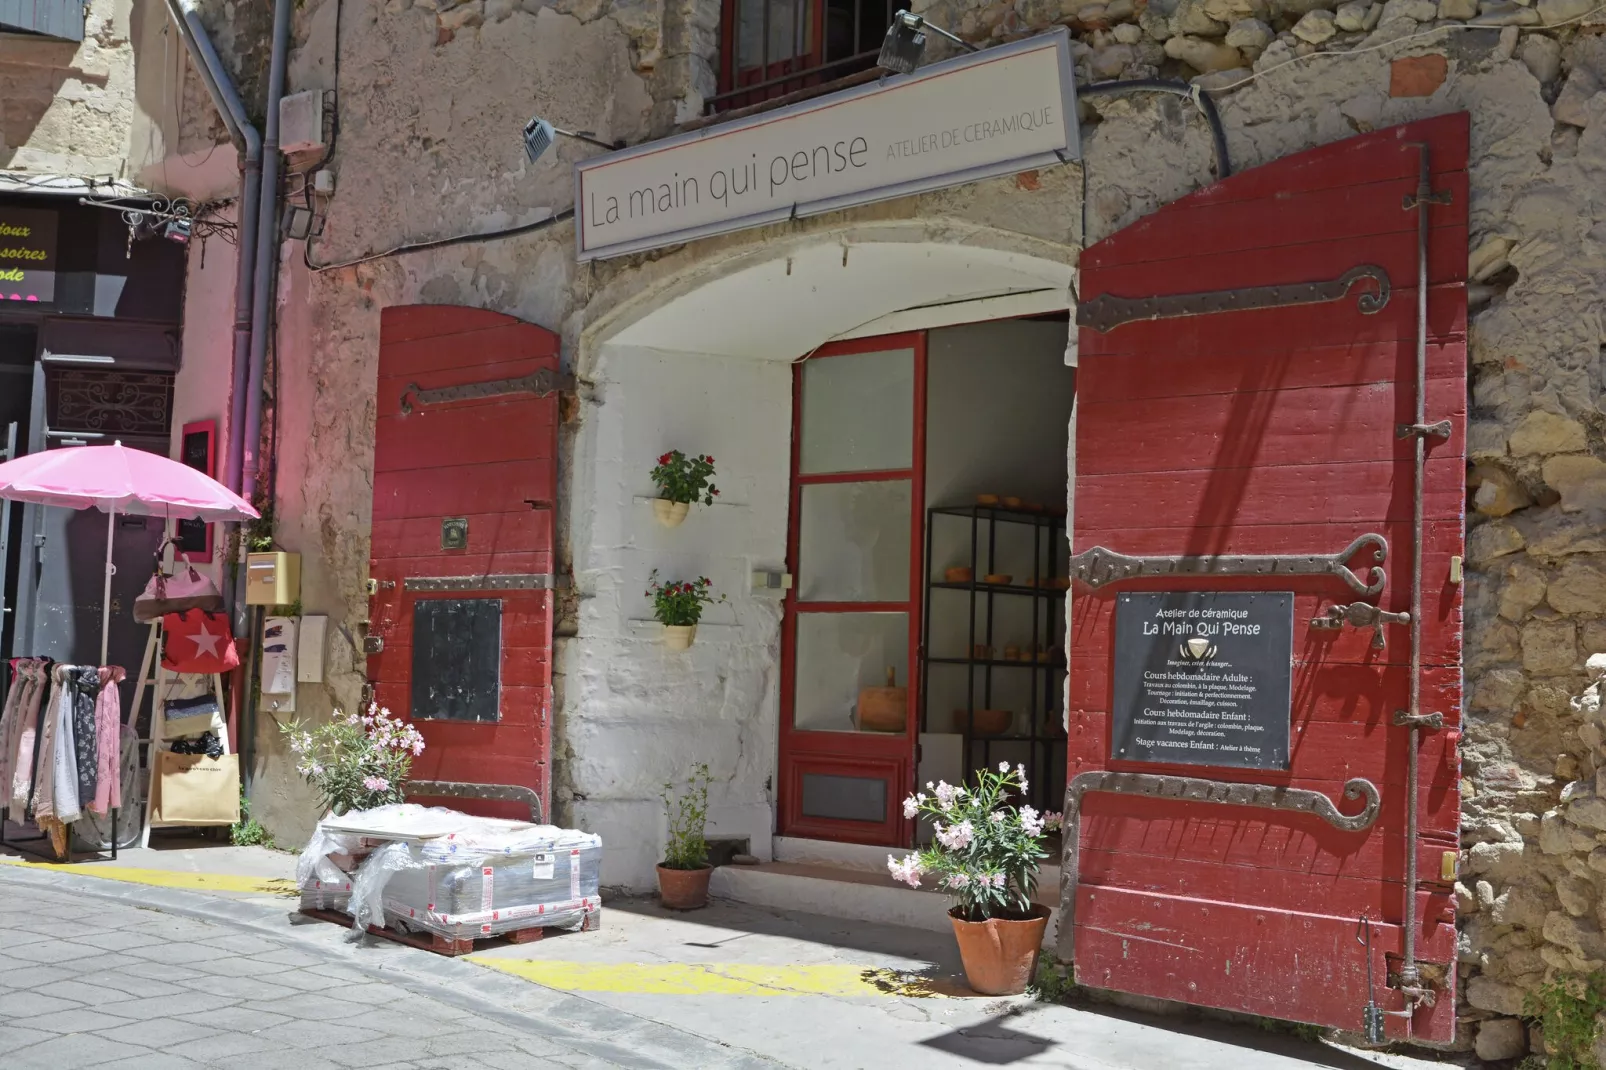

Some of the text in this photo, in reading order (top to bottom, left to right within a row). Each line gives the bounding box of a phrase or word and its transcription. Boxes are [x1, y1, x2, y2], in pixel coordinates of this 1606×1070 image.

[886, 106, 1054, 161] ATELIER DE CERAMIQUE
[591, 137, 868, 227] La main qui pense
[1155, 608, 1248, 620] Atelier de céramique
[1142, 622, 1260, 636] La Main Qui Pense
[1144, 670, 1166, 680] Cours
[1168, 672, 1220, 681] hebdomadaire
[1222, 673, 1248, 682] Adulte
[1147, 689, 1171, 697] Tournage
[1144, 708, 1166, 716] Cours
[1167, 709, 1220, 719] hebdomadaire
[1221, 711, 1246, 720] Enfant
[1136, 737, 1155, 748] Stage
[1190, 740, 1214, 750] Enfant
